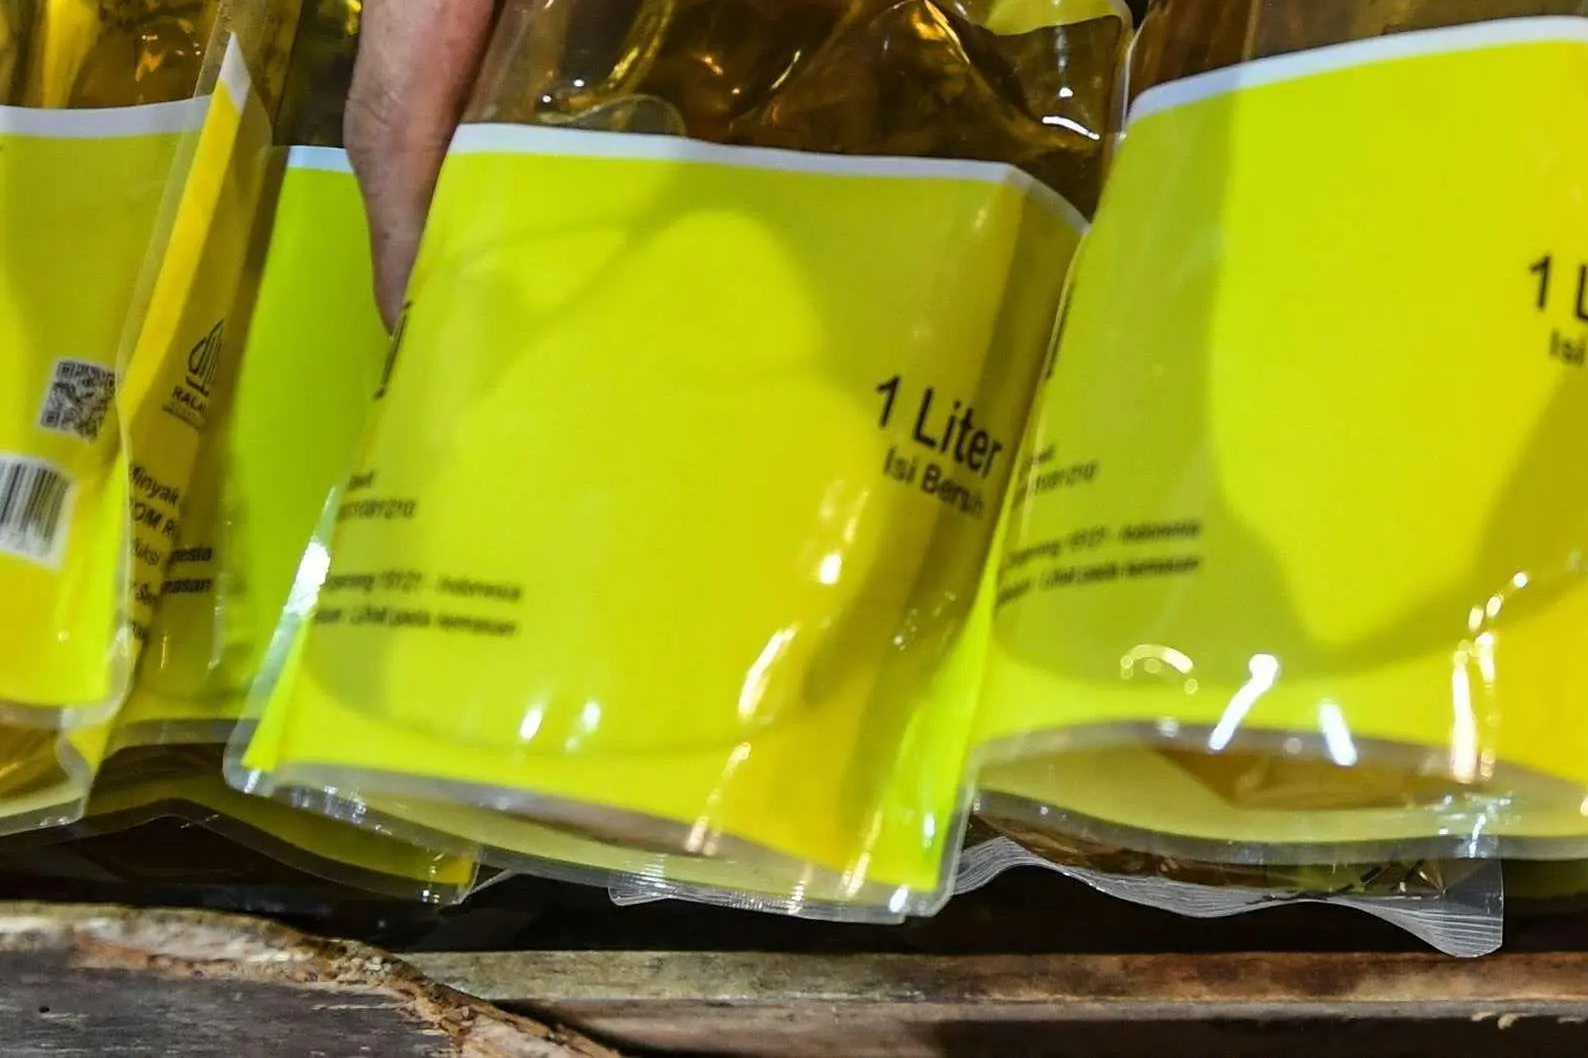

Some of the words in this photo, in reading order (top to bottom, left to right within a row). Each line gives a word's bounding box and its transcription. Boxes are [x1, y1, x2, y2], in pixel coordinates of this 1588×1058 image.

[1528, 255, 1551, 311] 1
[1549, 330, 1586, 367] Isi
[875, 374, 901, 429] 1
[912, 385, 1003, 479] Liter
[883, 446, 918, 484] Isi
